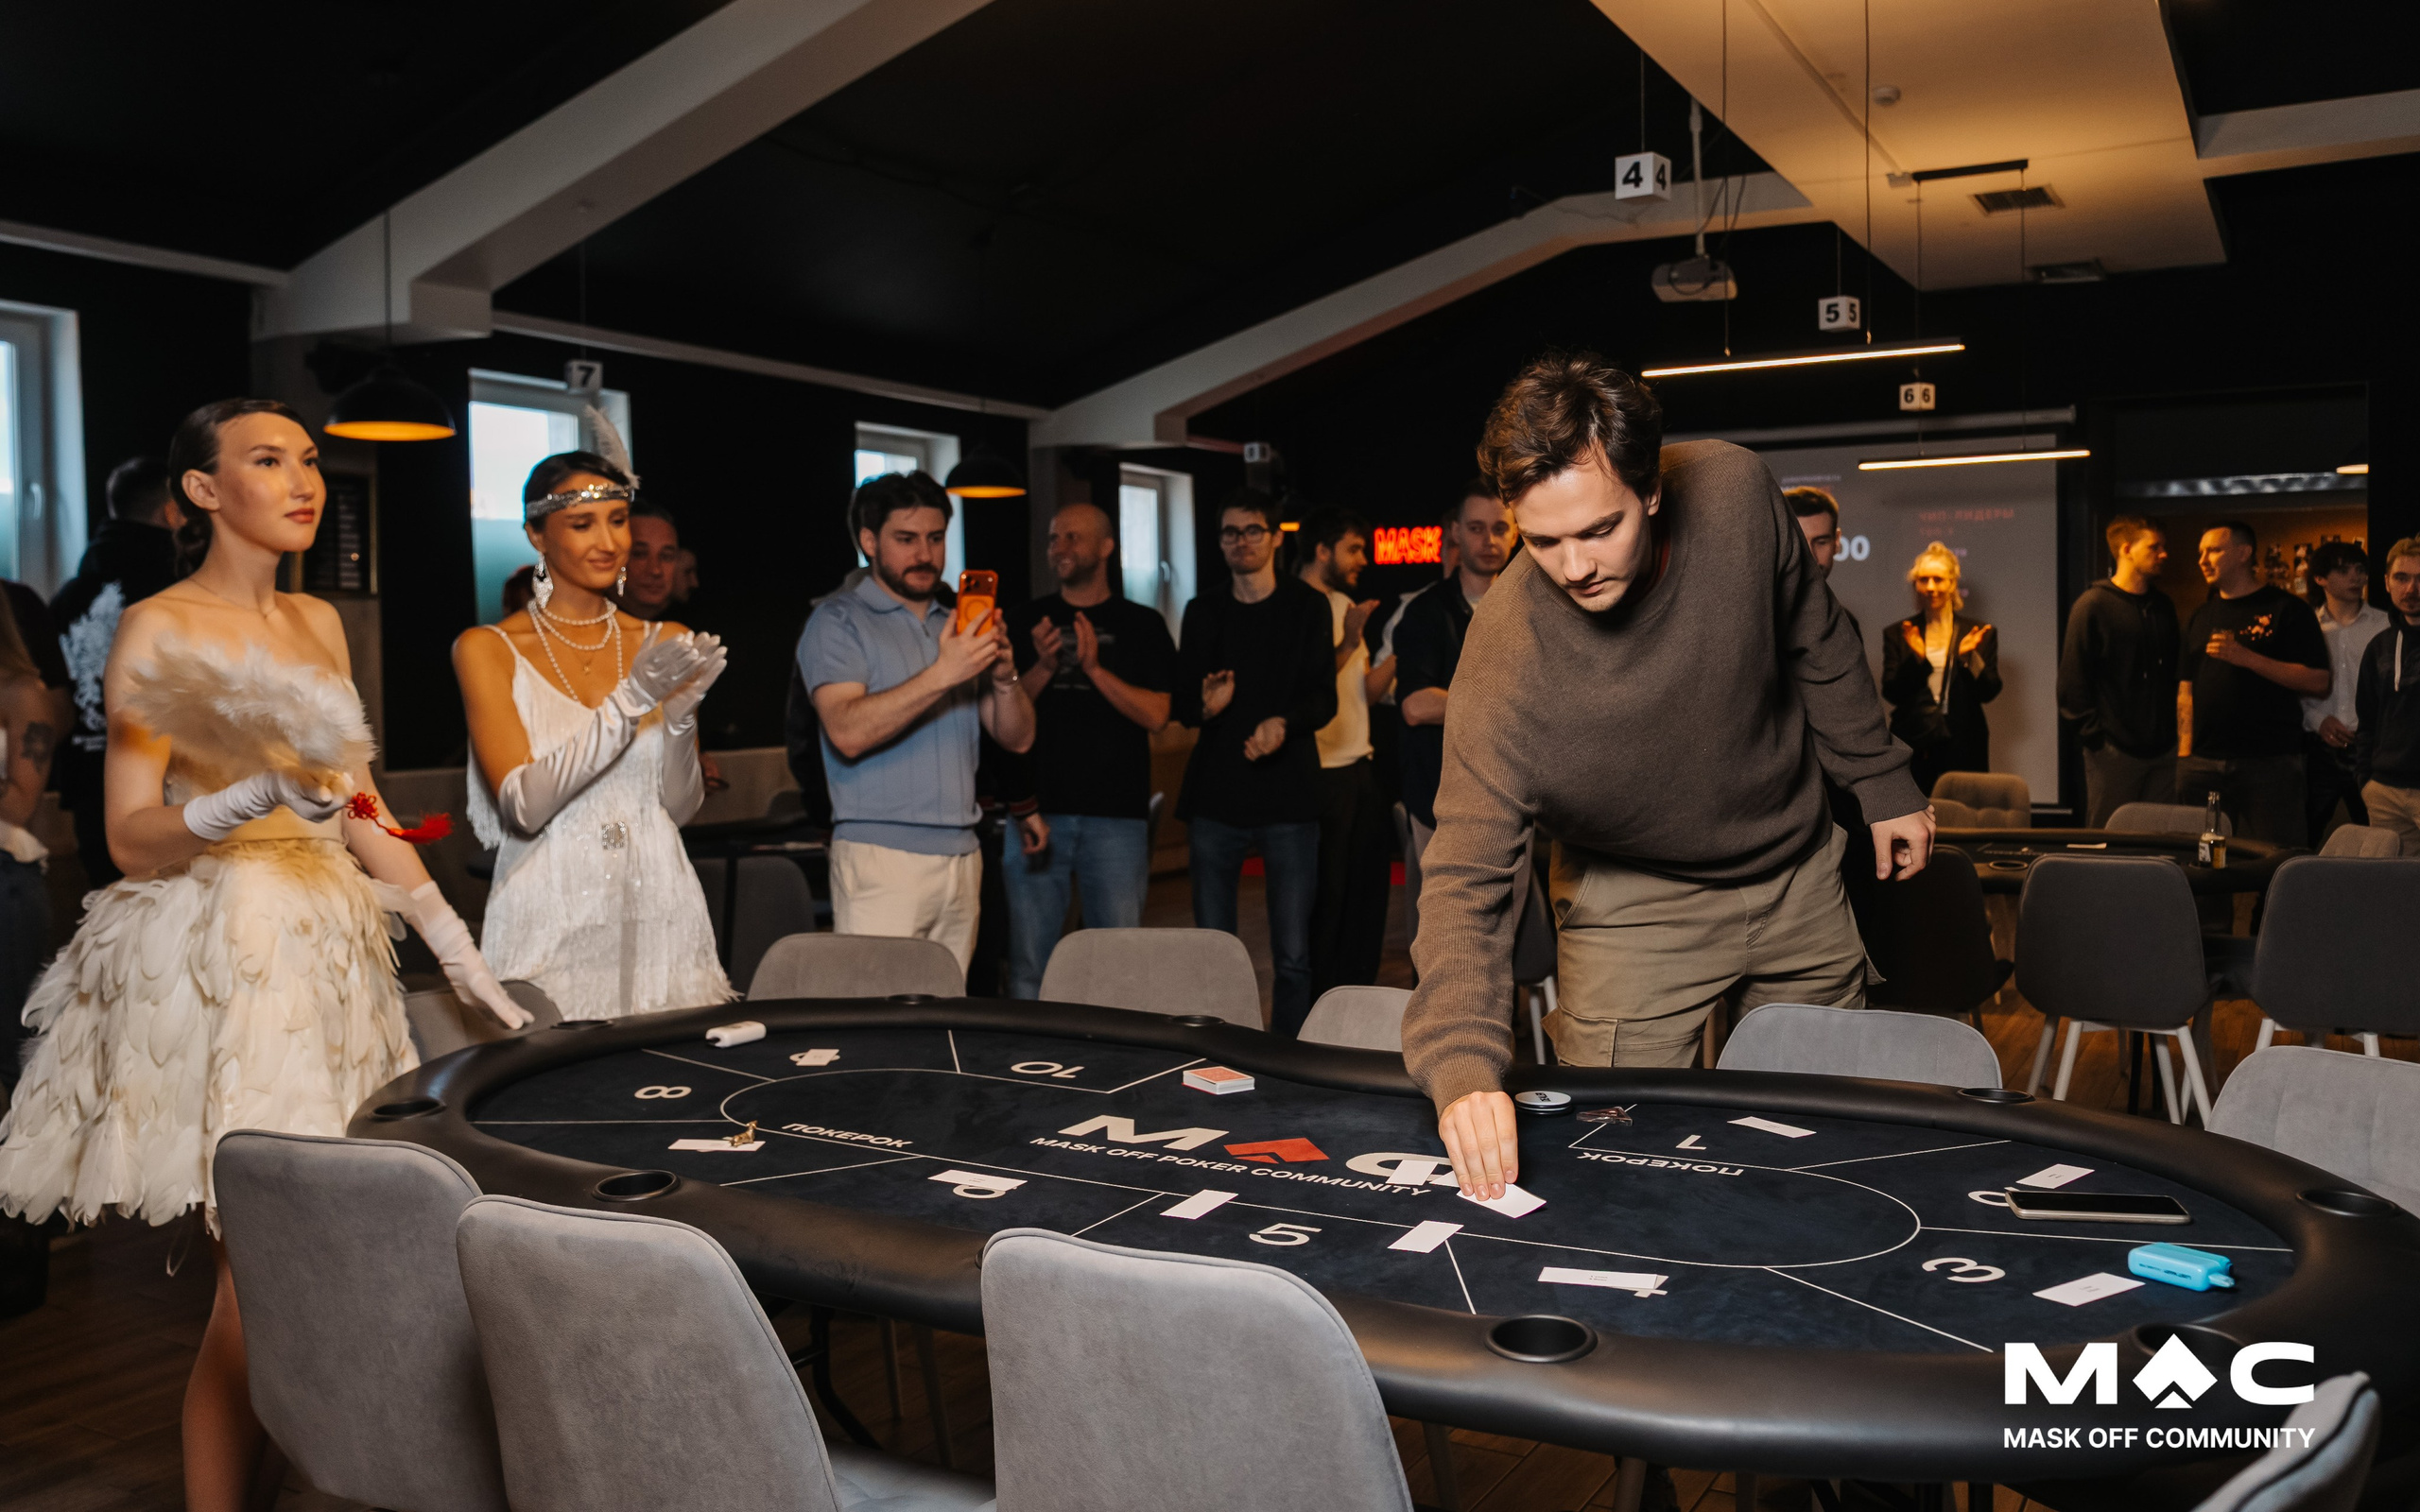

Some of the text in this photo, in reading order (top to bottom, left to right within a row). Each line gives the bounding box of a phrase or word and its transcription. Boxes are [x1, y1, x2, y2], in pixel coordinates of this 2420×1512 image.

[1622, 161, 1643, 188] 4
[1655, 163, 1667, 191] 4
[1825, 303, 1840, 323] 5
[1849, 303, 1857, 323] 5
[578, 366, 596, 387] 7
[1904, 387, 1914, 404] 6
[1923, 387, 1930, 404] 6
[1374, 525, 1443, 564] MASK
[1029, 1137, 1431, 1196] MASK OFF POKER COMMUNITY
[1249, 1223, 1322, 1246] 5
[1922, 1257, 2006, 1282] 3
